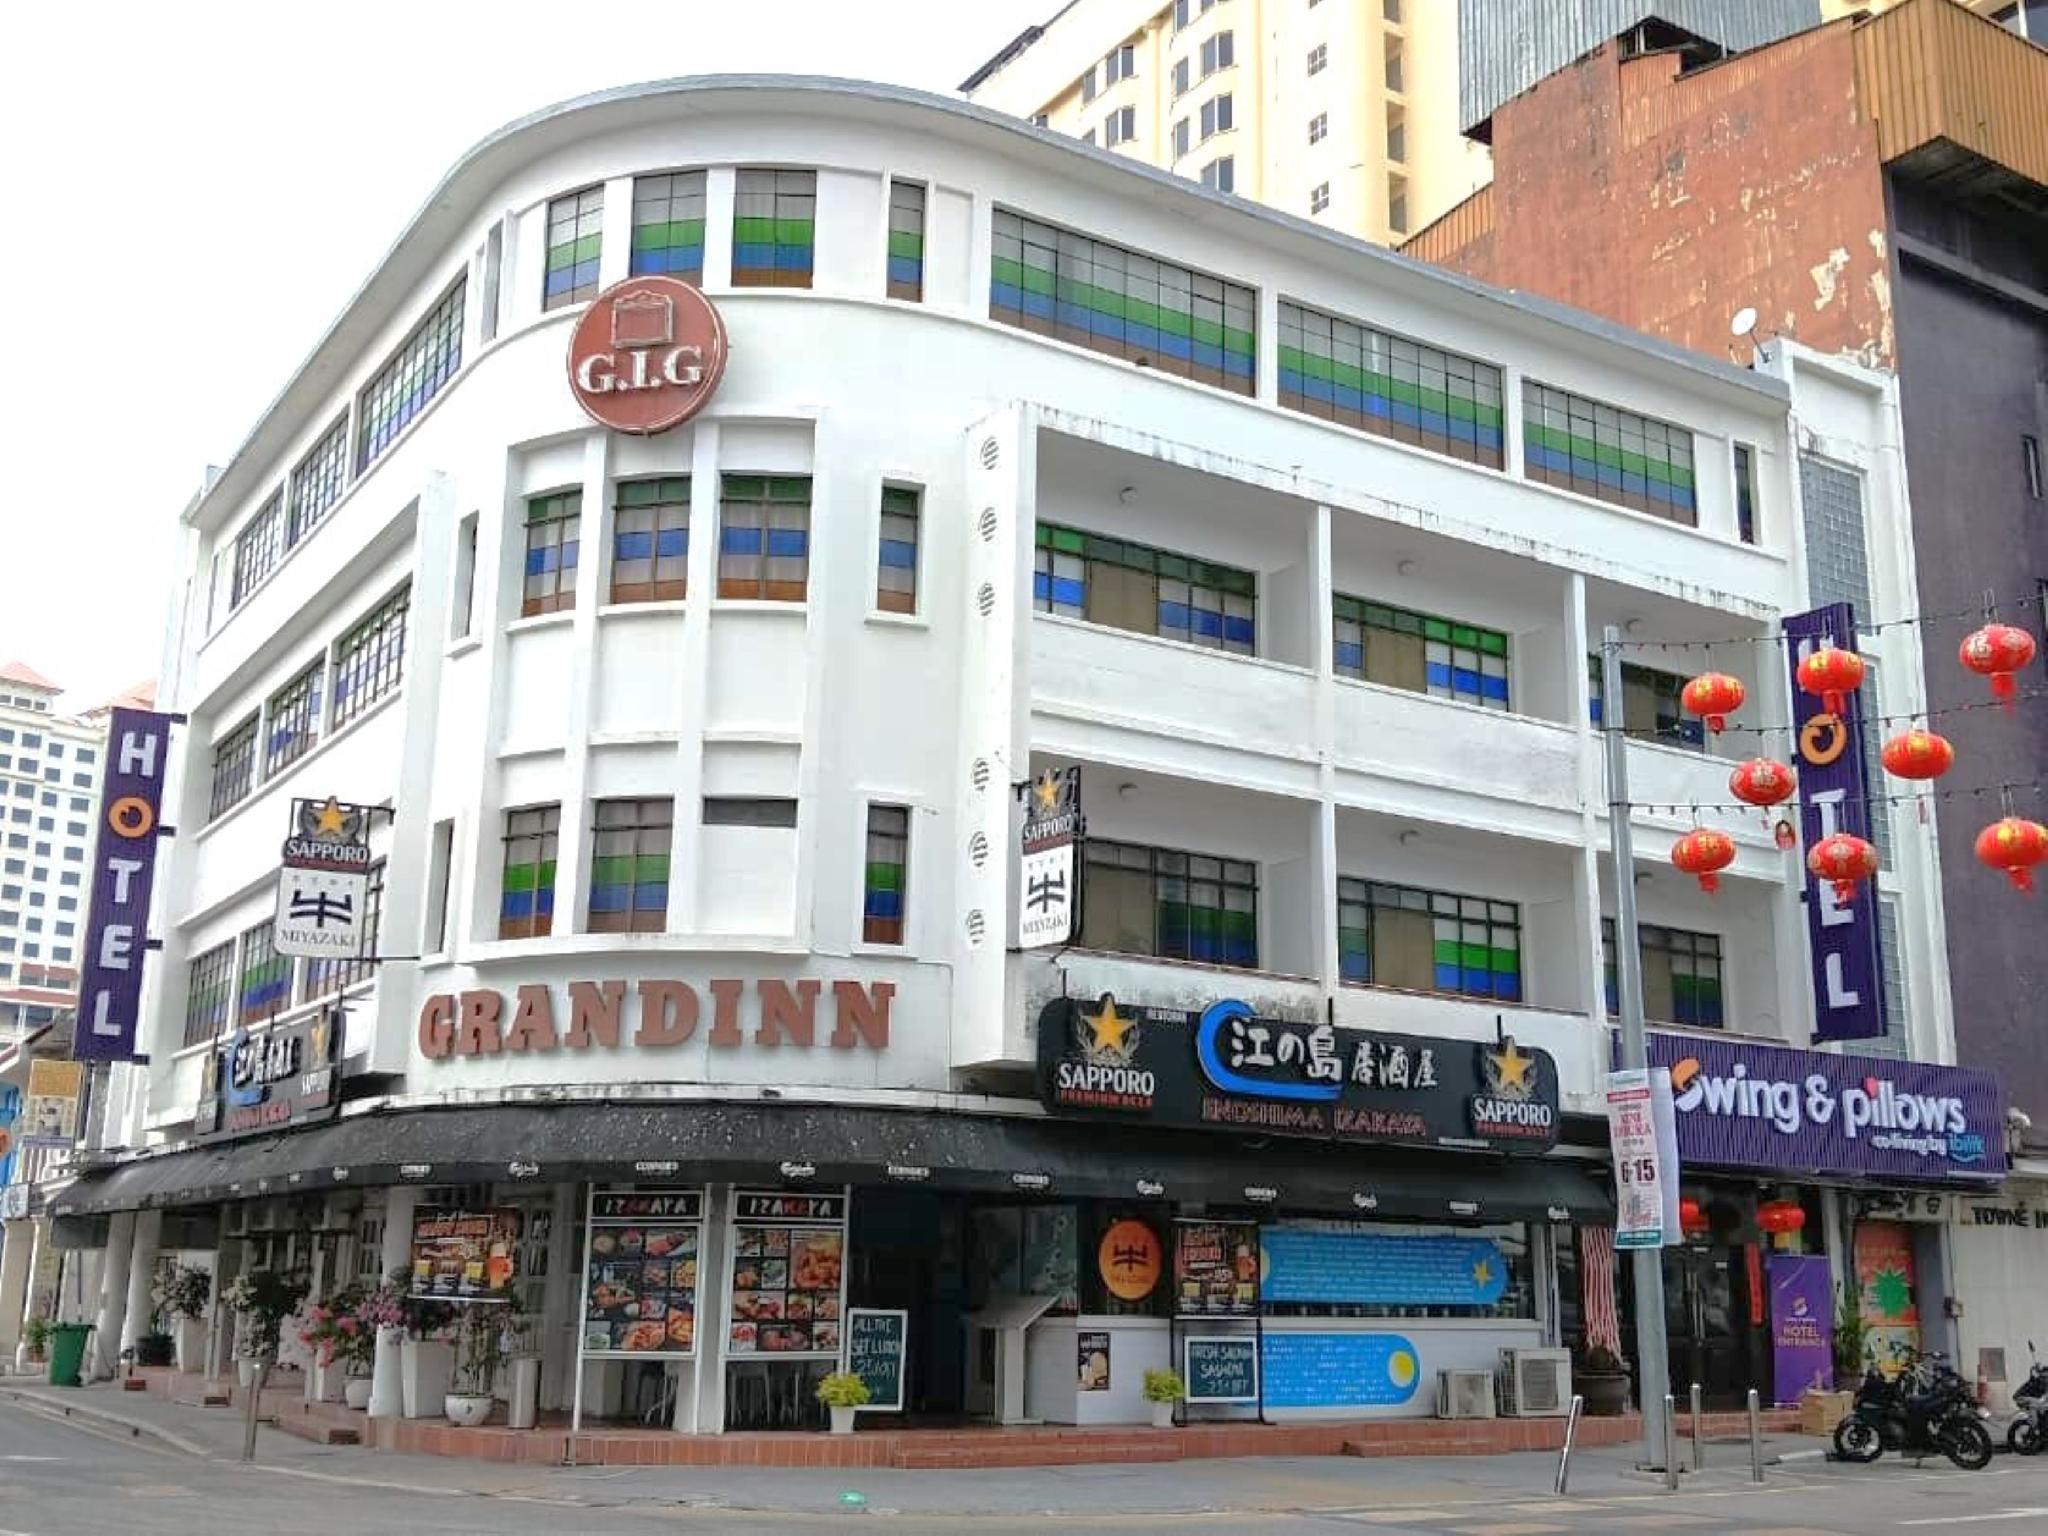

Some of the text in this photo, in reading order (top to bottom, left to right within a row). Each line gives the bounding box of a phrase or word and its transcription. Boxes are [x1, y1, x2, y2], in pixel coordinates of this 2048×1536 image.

[286, 838, 369, 864] SAPPORO
[93, 732, 157, 1036] HOTEL
[280, 928, 357, 948] MIYAZAKI
[1058, 1061, 1156, 1096] SAPPORO
[1473, 1097, 1552, 1128] SAPPORO
[1804, 1074, 1837, 1124] &
